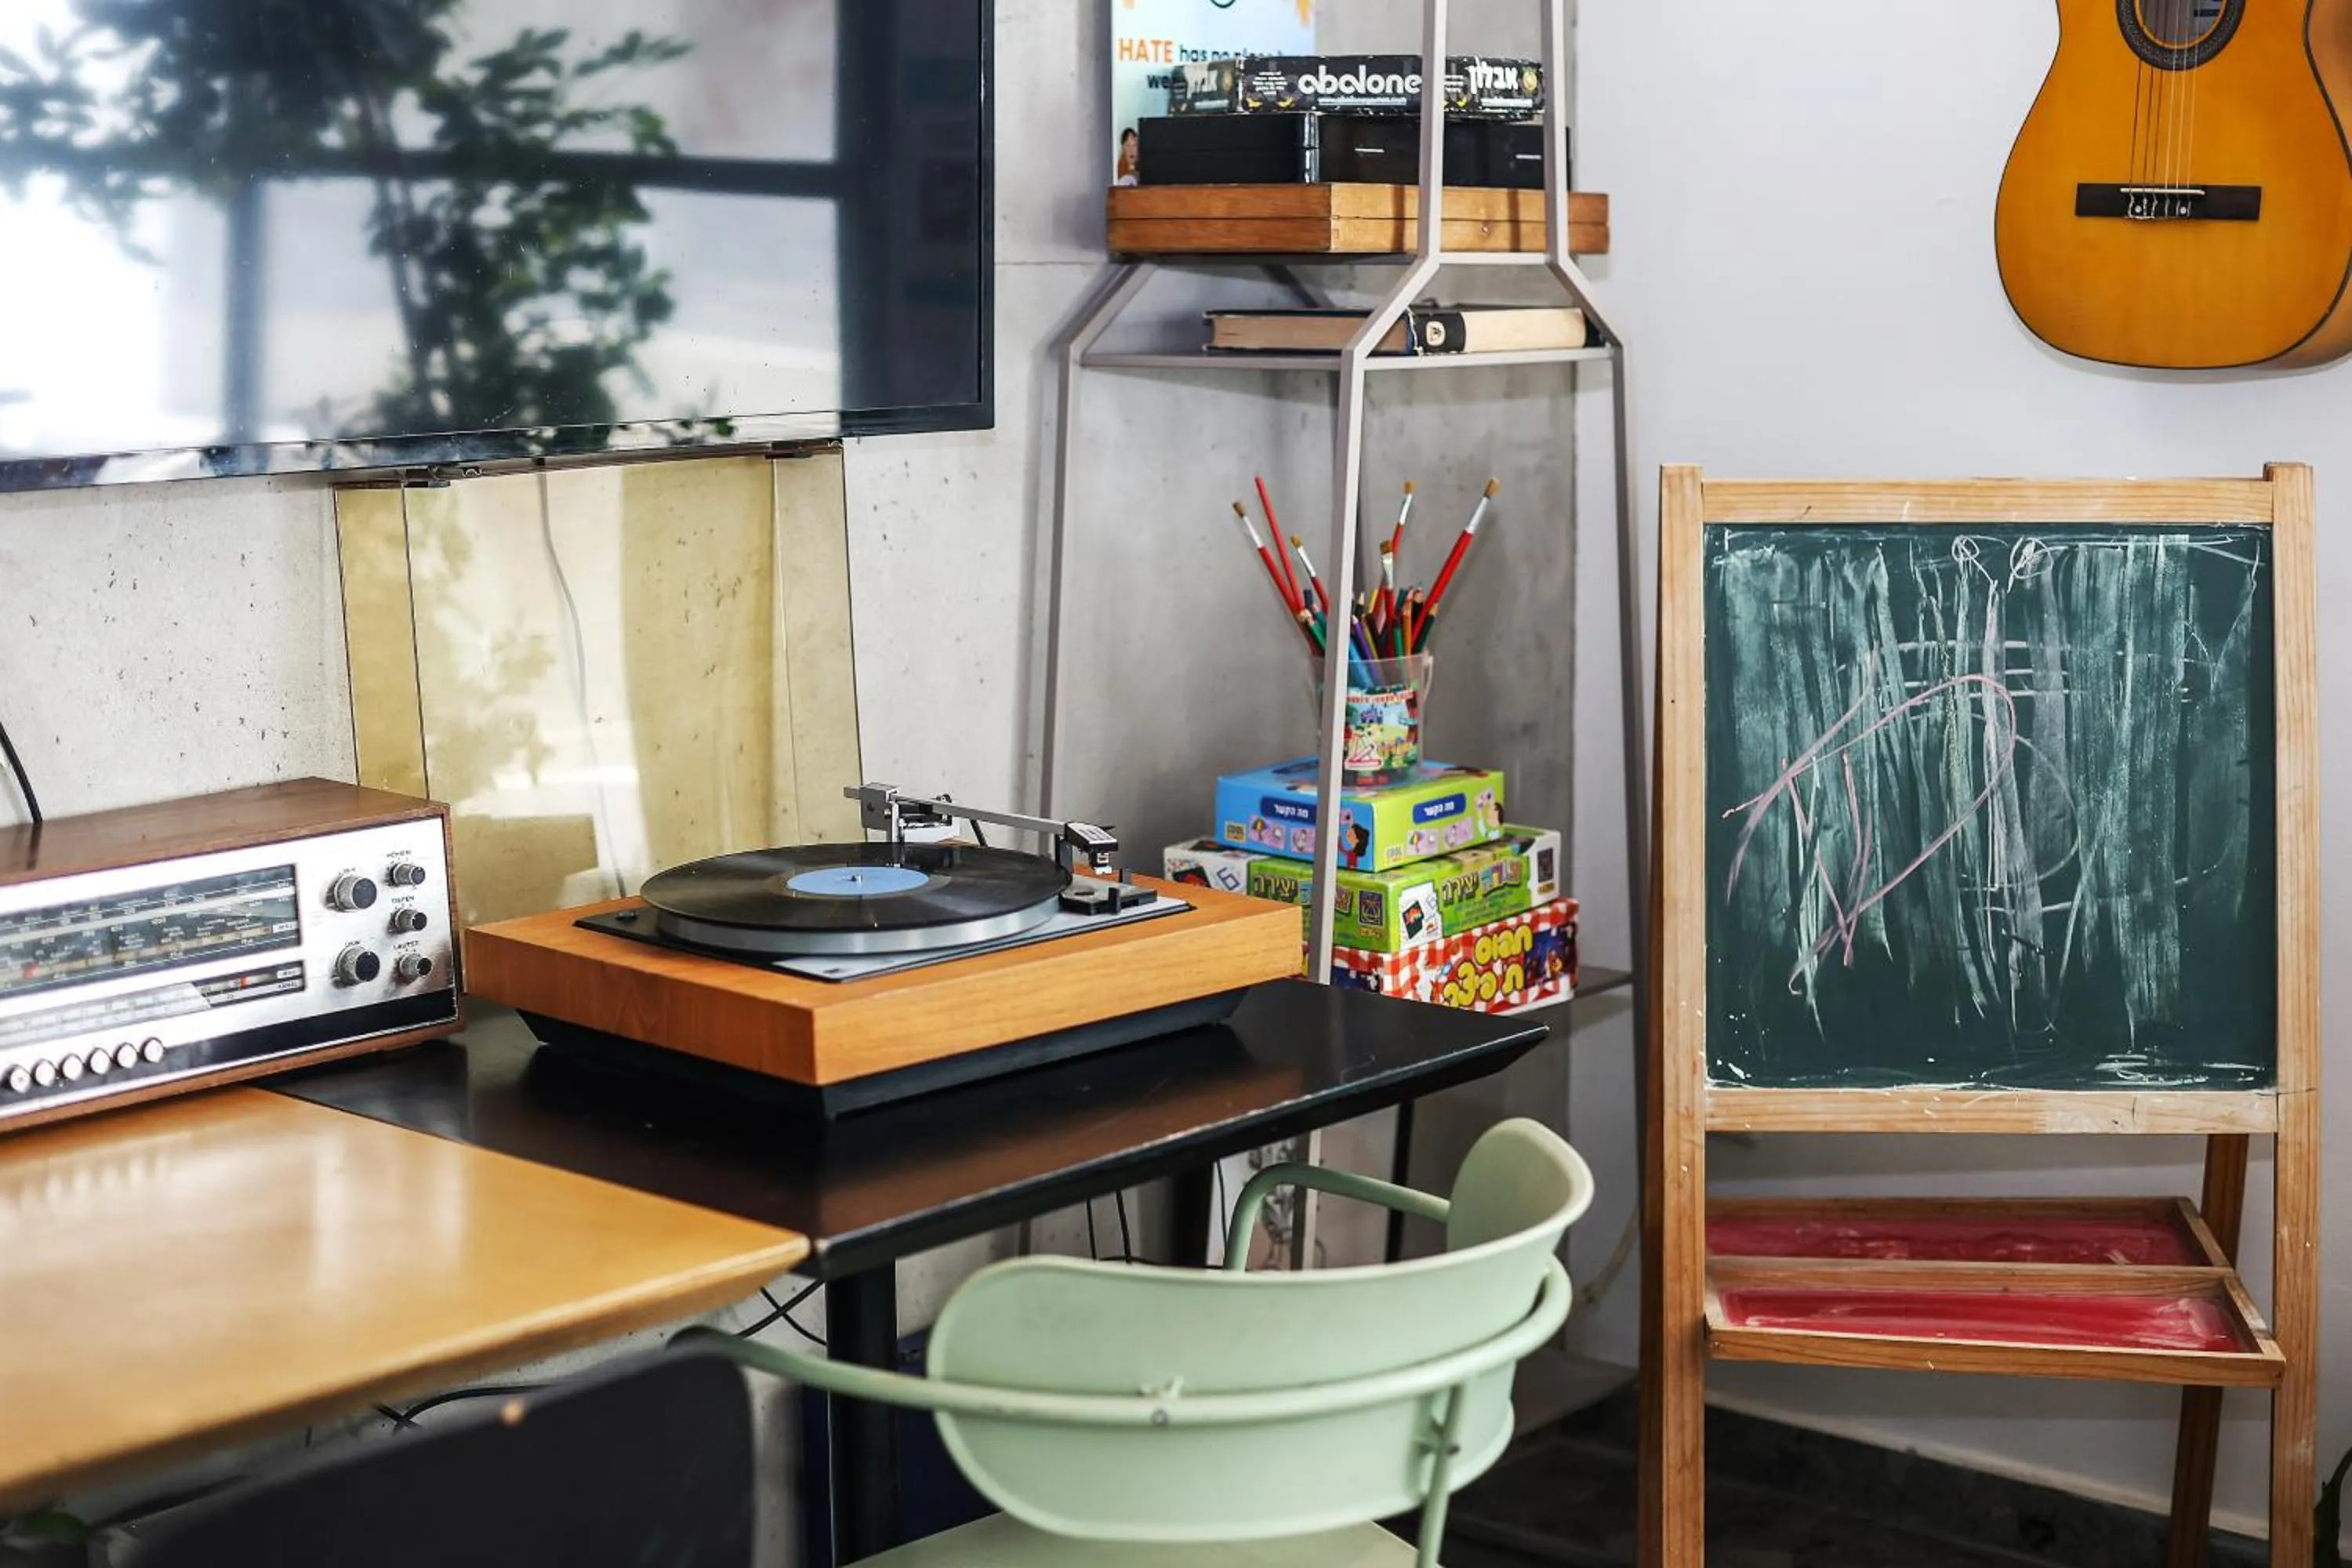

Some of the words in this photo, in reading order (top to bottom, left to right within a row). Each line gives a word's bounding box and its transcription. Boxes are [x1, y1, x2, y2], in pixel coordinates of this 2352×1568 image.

[1119, 38, 1174, 63] HATE
[1179, 44, 1207, 62] has
[1298, 64, 1422, 95] abalone
